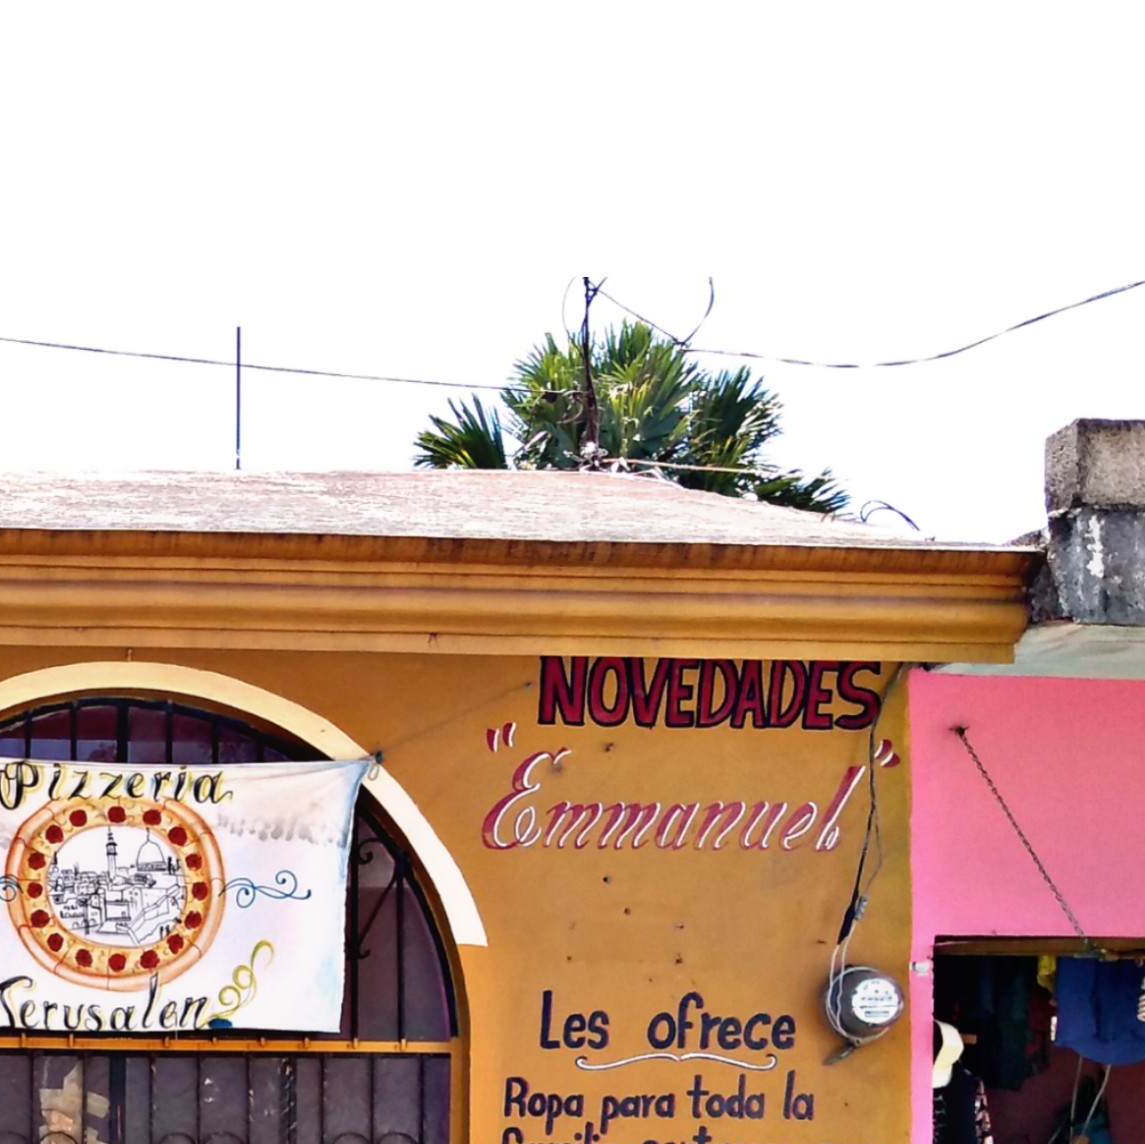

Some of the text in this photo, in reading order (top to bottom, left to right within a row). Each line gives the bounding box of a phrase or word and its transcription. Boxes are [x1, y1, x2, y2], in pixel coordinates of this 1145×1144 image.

[537, 656, 883, 731] NOVEDADES
[539, 989, 610, 1050] Les
[647, 991, 796, 1051] ofrece
[502, 1070, 815, 1135] Ropa para toda la
